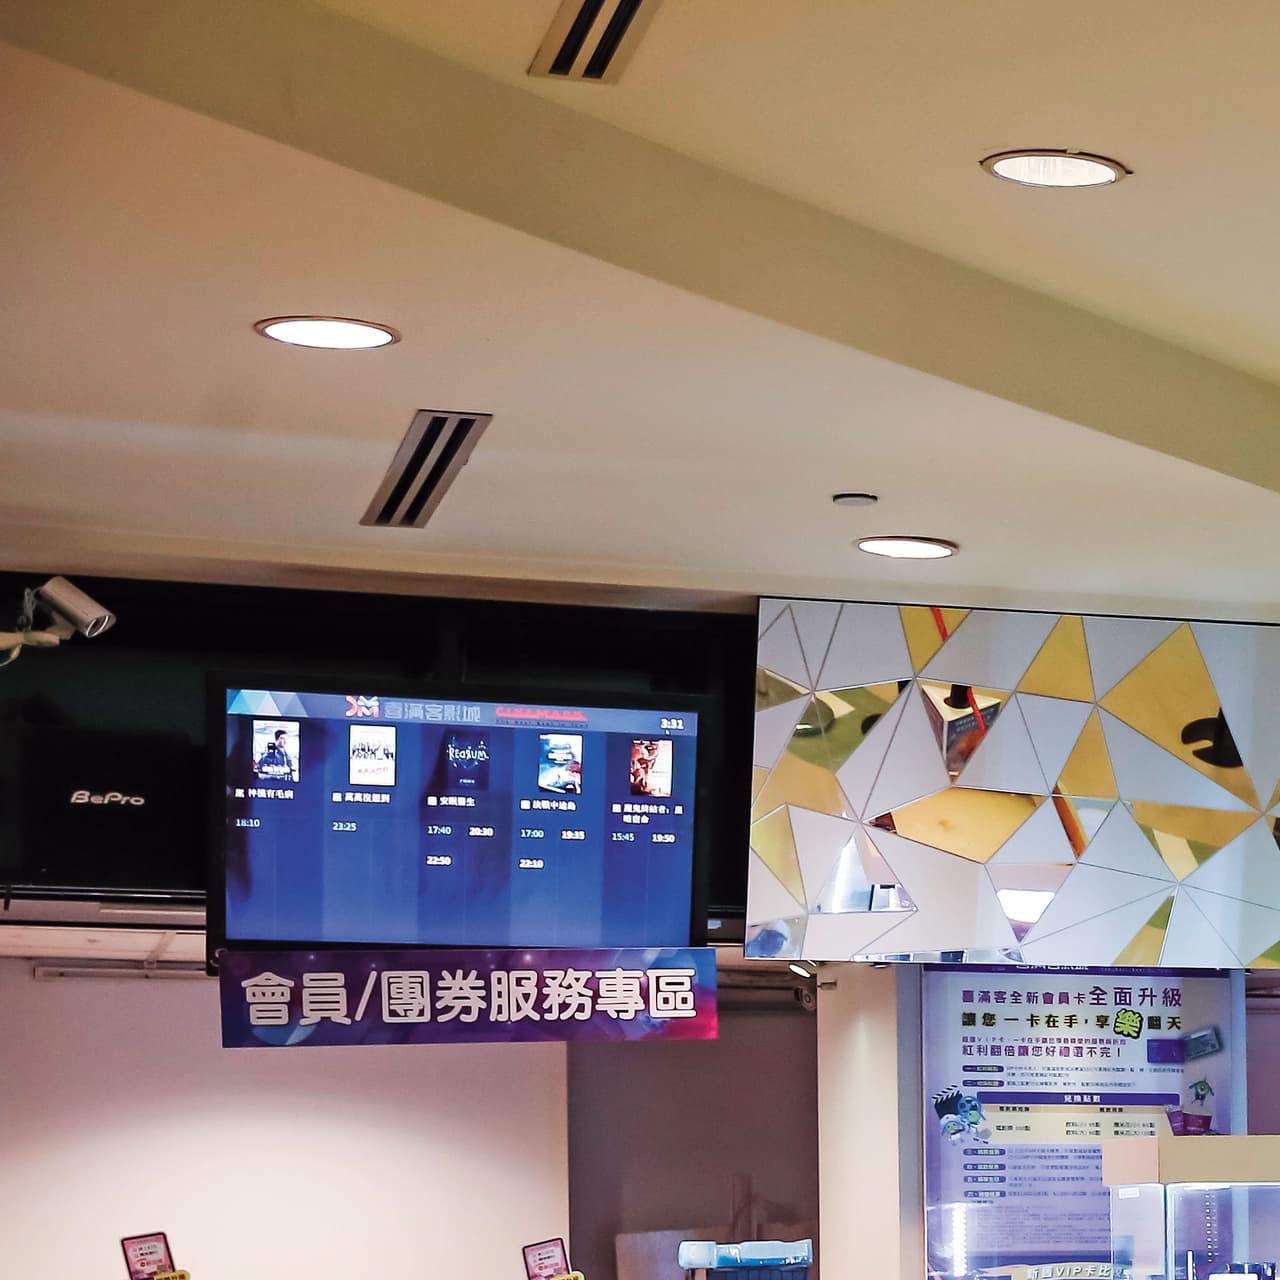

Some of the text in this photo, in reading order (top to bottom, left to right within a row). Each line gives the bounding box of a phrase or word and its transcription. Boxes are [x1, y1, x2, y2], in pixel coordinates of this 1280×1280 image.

[332, 822, 357, 832] 23:25
[427, 825, 452, 836] 17:40
[520, 829, 545, 839] 17:00
[612, 831, 635, 842] 15:45
[240, 966, 698, 1027] 會員/團券服務專區
[961, 985, 1182, 1007] 喜滿客全新會員卡全面升級
